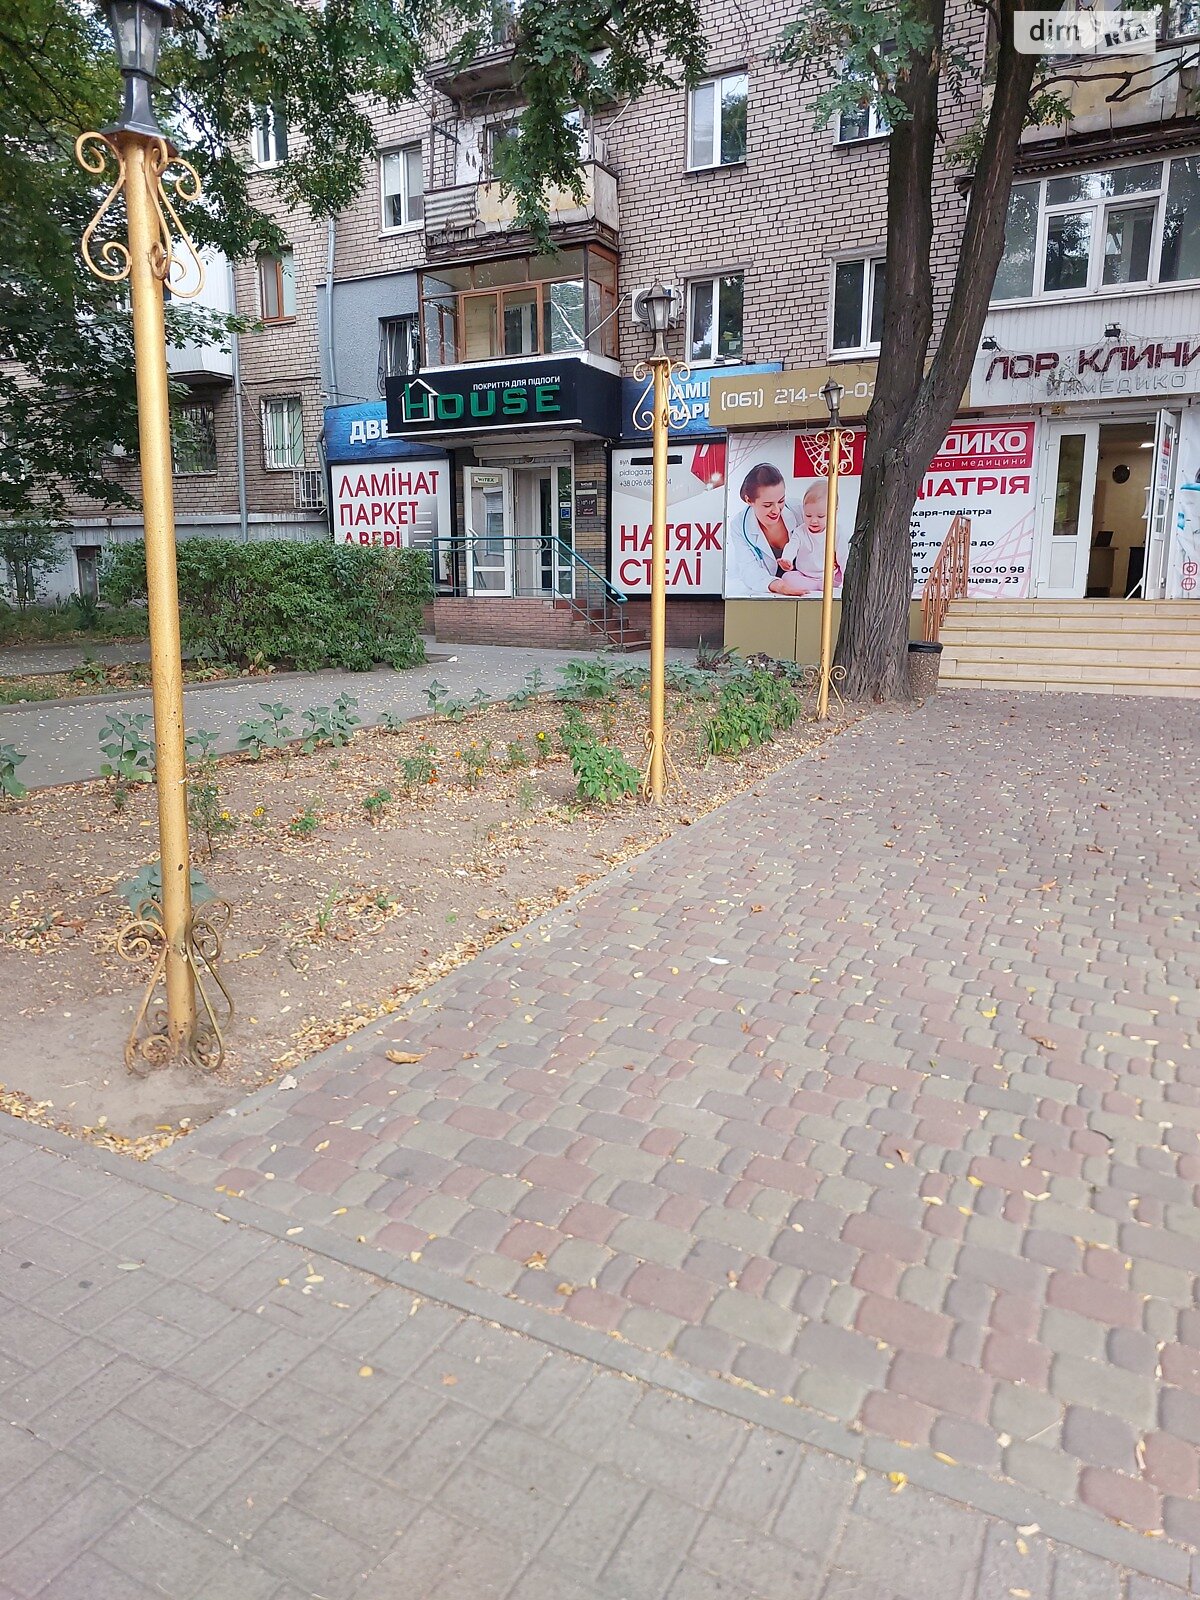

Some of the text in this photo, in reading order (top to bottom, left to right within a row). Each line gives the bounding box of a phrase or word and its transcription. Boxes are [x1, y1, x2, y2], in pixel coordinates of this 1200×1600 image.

[986, 352, 1060, 382] ЛОР
[472, 376, 560, 391] ПОКРИТТЯ ДЛЯ ПІДЛОГИ
[668, 381, 710, 400] АМІ
[404, 382, 561, 421] HOUSE
[721, 387, 764, 411] (061)
[961, 458, 1027, 468] медицини
[338, 467, 439, 499] ЛАМІНАТ
[339, 500, 419, 527] ПАРКЕТ
[619, 522, 723, 552] НАТЯЖ
[979, 540, 995, 549] до
[972, 566, 992, 574] 100
[994, 566, 1007, 574] 10
[1009, 566, 1025, 574] 98
[1004, 576, 1019, 584] 23
